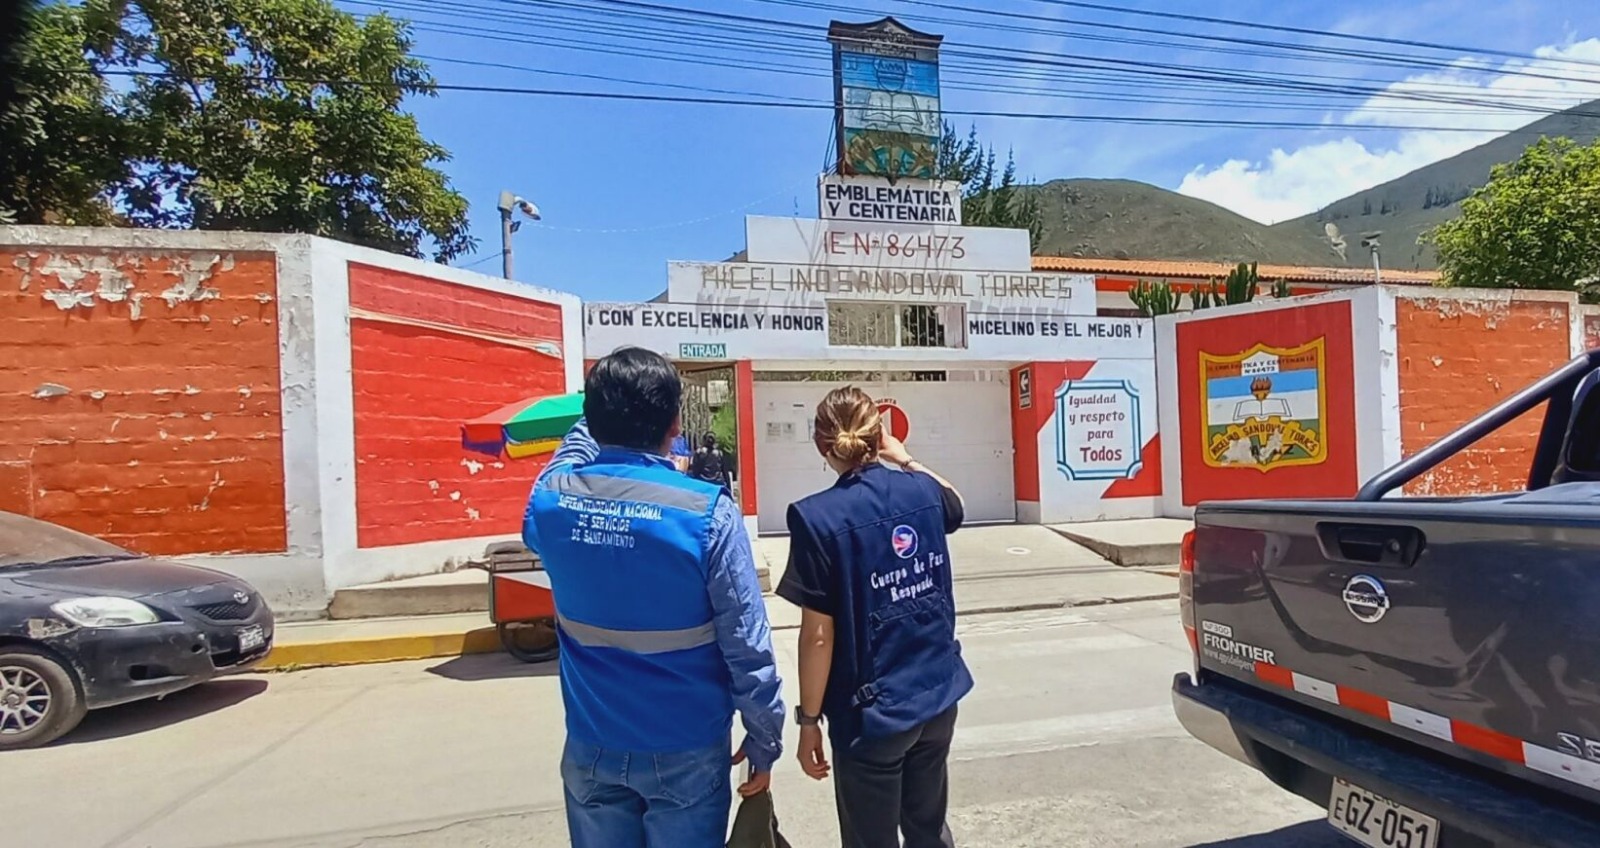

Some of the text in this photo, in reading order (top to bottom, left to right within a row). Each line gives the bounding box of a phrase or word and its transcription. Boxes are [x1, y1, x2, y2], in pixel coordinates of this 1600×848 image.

[825, 184, 952, 206] EMBLEMÁTICA
[828, 201, 957, 222] Y CENTENARIA
[887, 234, 965, 259] 86473
[701, 265, 1072, 298] MICELINO SANDOVAL TORRES
[600, 310, 634, 326] CON
[642, 310, 749, 329] EXCELENCIA
[753, 314, 765, 329] Y
[772, 315, 824, 331] HONOR
[969, 320, 1035, 336] MICELINO
[1041, 322, 1059, 336] ES
[1064, 322, 1082, 337] EL
[1088, 323, 1132, 338] MEJOR
[681, 344, 726, 358] ENTRADA
[1069, 394, 1117, 408] Igualdad
[1069, 410, 1125, 425] y respeto
[1087, 429, 1113, 442] para
[1080, 447, 1122, 462] Todos
[558, 494, 663, 520] SUPERINTENDENCIA NACIONAL
[578, 514, 630, 532] DE SERVICIOS
[571, 528, 635, 548] DE SANEAMIENTO
[870, 567, 907, 589] Cuerpo
[914, 557, 925, 574] de
[1203, 633, 1276, 665] FRONTIER
